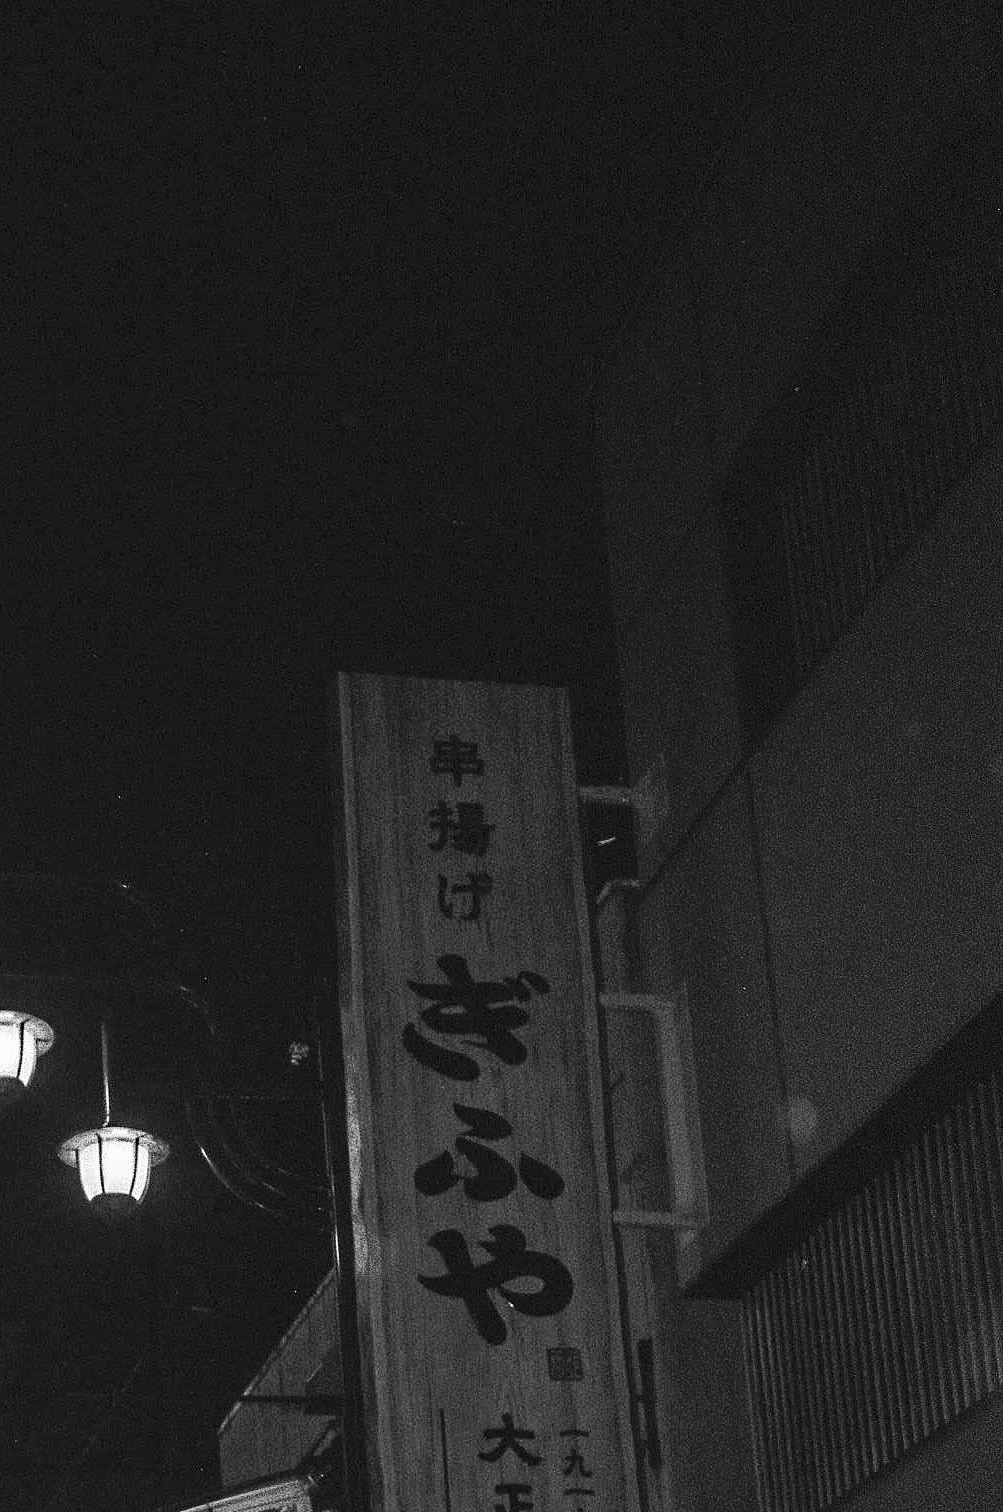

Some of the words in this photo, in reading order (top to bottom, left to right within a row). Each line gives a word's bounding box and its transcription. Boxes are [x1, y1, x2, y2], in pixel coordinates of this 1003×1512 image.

[429, 735, 495, 920] 串揚げ
[402, 953, 575, 1346] ぎふや
